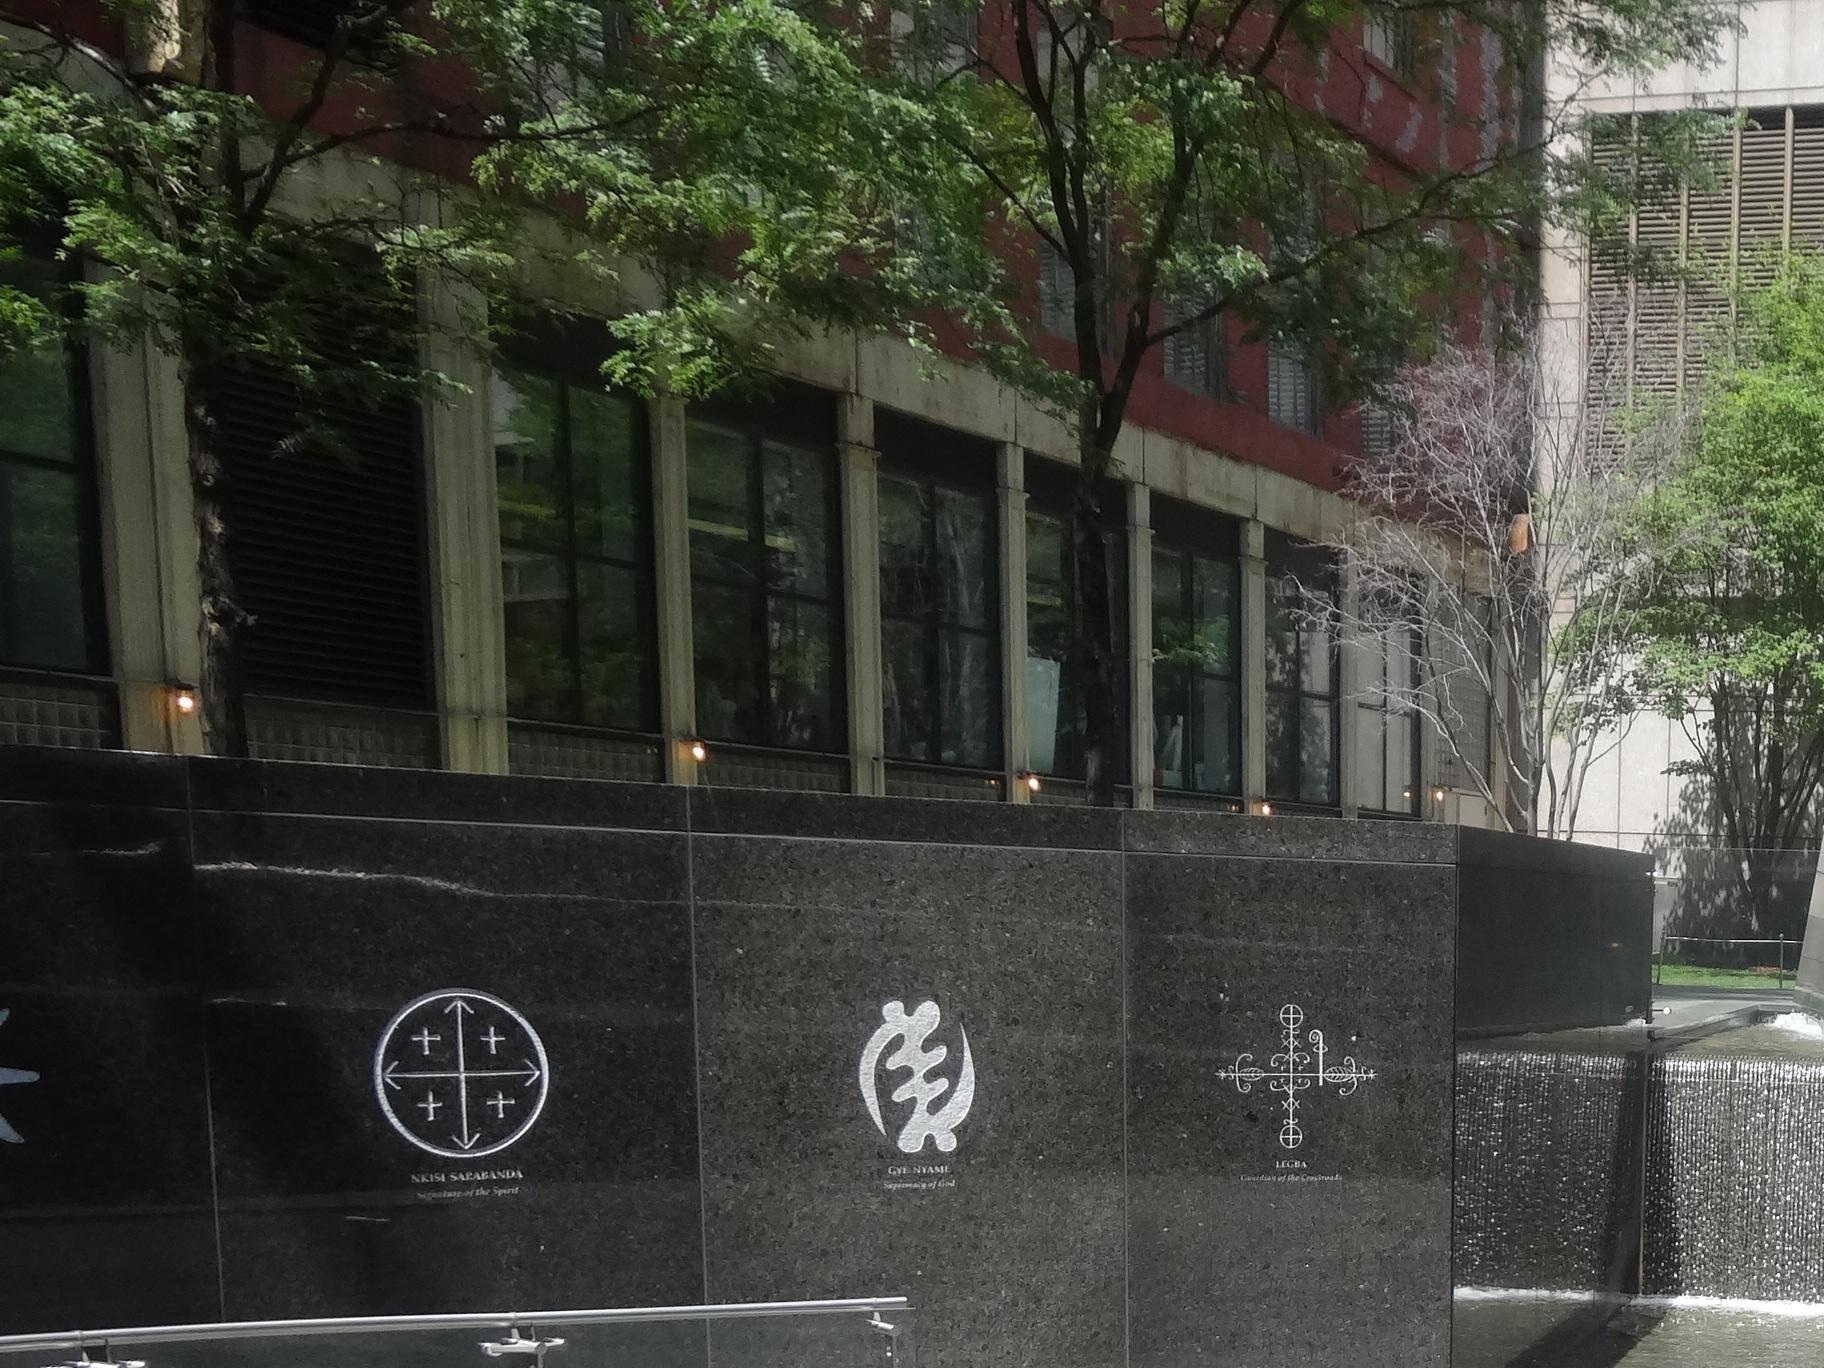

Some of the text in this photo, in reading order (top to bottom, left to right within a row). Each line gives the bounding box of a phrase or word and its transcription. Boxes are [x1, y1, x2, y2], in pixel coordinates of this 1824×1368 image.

[1276, 1160, 1307, 1168] LEGBA
[888, 1165, 951, 1175] GYE NYAME
[411, 1169, 524, 1183] NKISI SARABANDA
[1277, 1174, 1287, 1183] of
[1288, 1173, 1300, 1181] the
[928, 1180, 936, 1189] of
[476, 1187, 490, 1197] the
